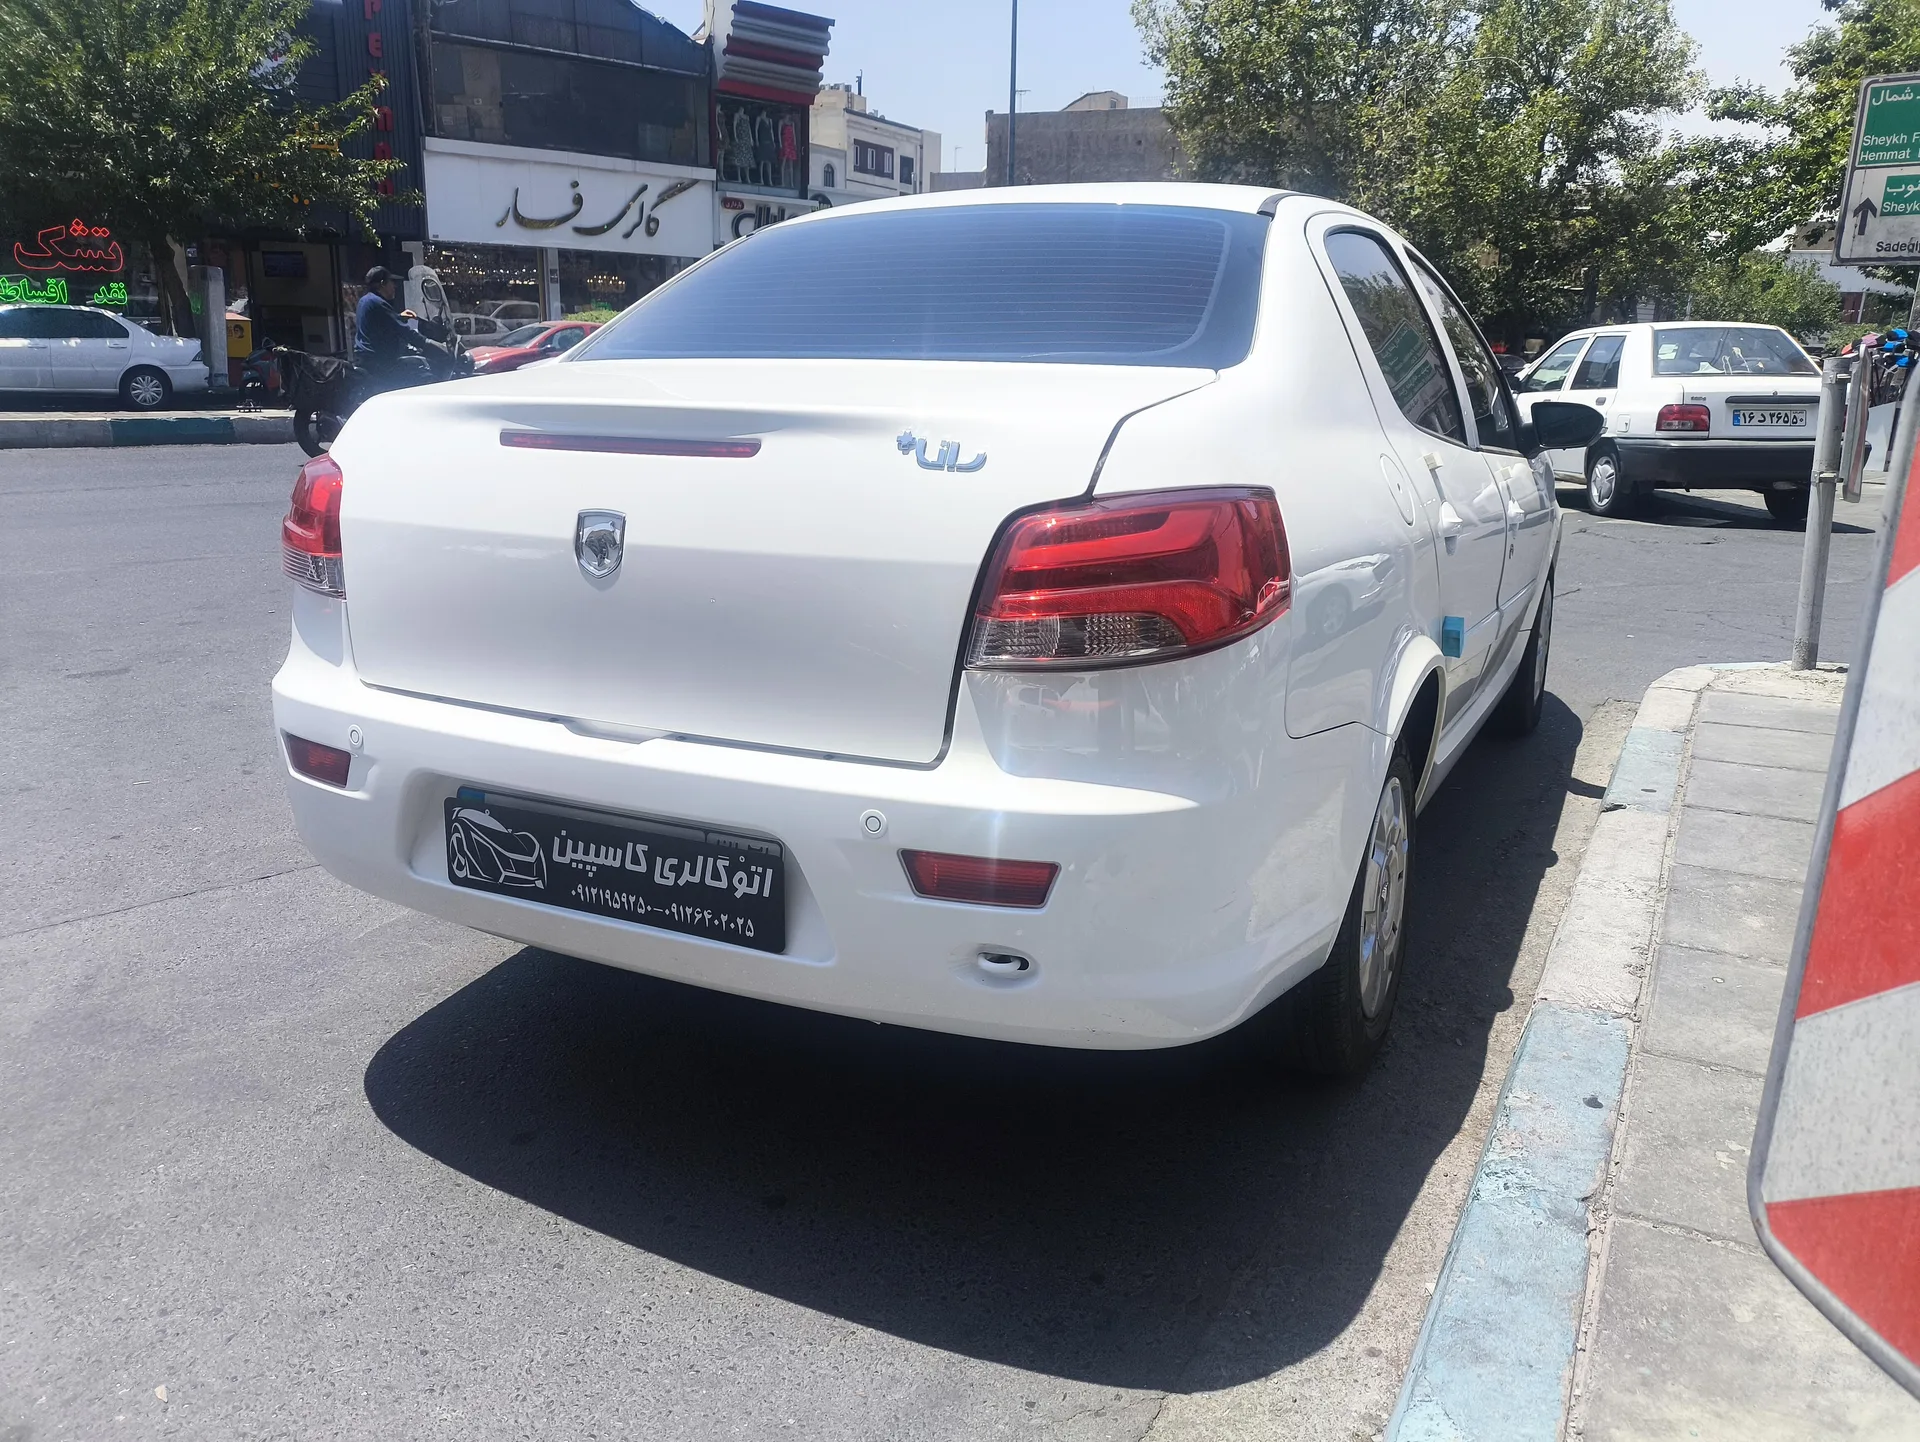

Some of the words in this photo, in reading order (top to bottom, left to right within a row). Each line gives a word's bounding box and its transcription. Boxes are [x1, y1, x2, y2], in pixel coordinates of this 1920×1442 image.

[1872, 86, 1914, 107] شمال
[1862, 132, 1907, 147] Sheykh
[1859, 148, 1911, 162] Hemmat
[14, 218, 124, 272] تشک
[93, 282, 128, 305] نقد
[551, 830, 648, 877] کاسپین
